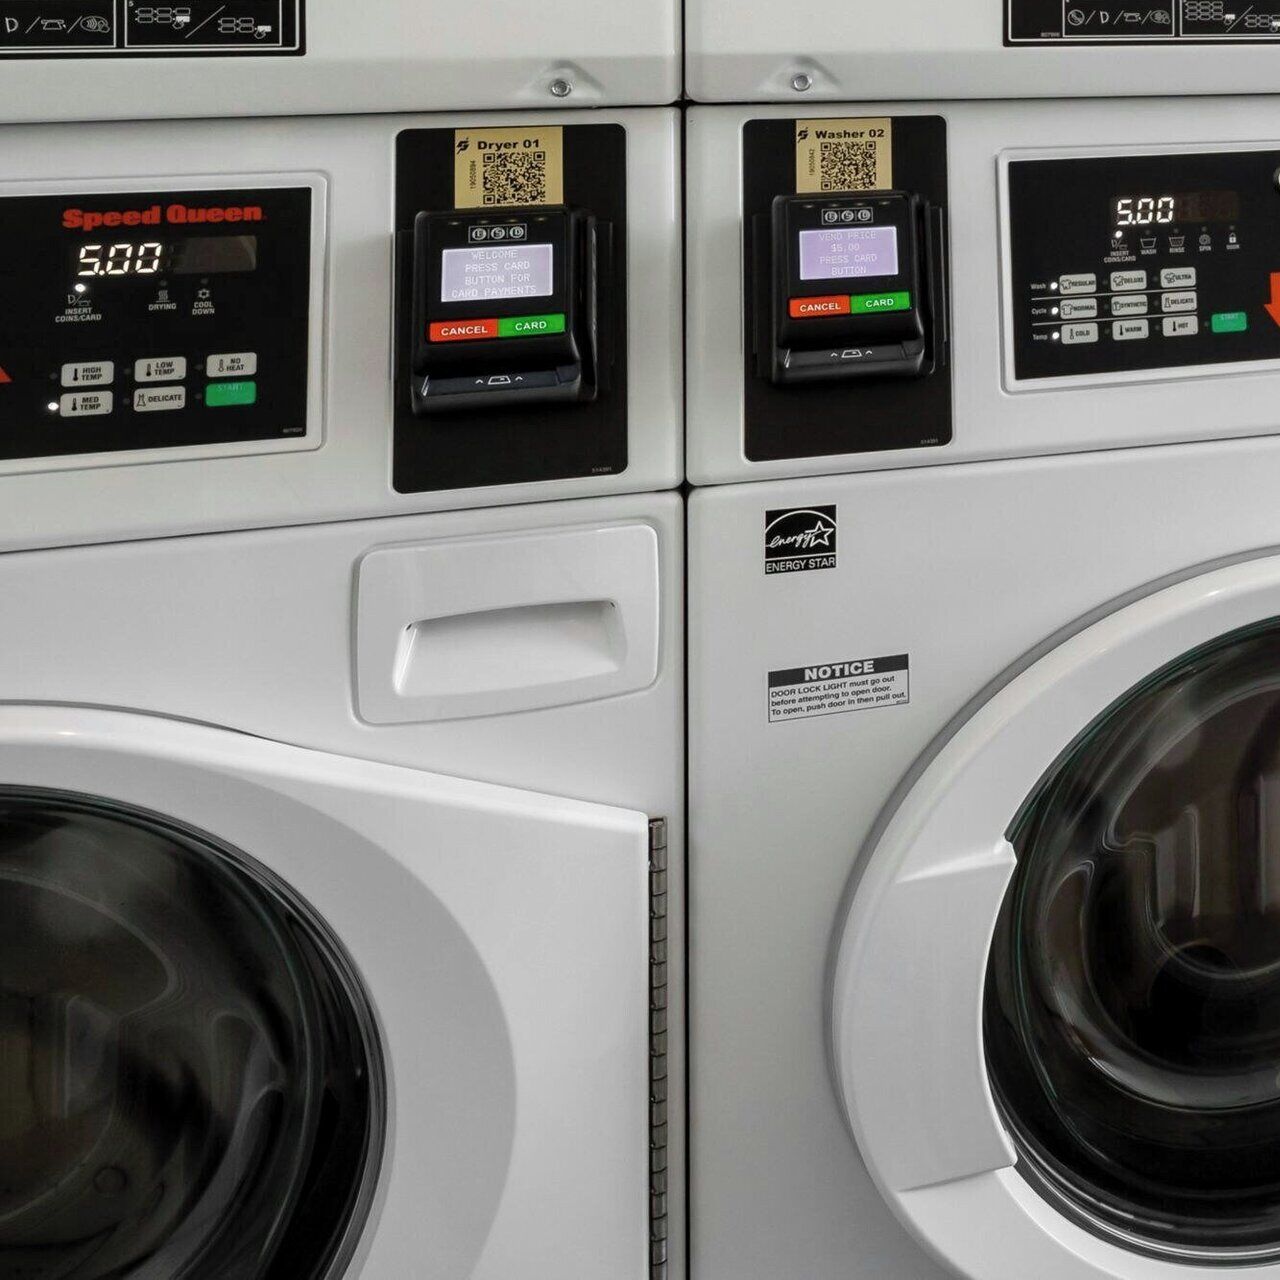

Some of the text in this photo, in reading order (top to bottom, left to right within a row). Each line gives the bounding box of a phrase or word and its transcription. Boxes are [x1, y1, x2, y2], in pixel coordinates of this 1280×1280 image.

[815, 129, 884, 139] Washer 02
[477, 139, 540, 151] Dryer 01
[1117, 197, 1174, 226] 5.00
[62, 204, 262, 231] Speed Queen
[820, 231, 876, 241] VEND PRICE
[78, 242, 162, 276] 5.00
[471, 250, 518, 260] WELCOME
[820, 254, 877, 264] PRESS CARD
[465, 261, 530, 272] PRESS CARD
[831, 267, 867, 275] BUTTON
[465, 274, 530, 285] BUTTON FOR
[452, 286, 536, 298] CARD PAYMENTS
[149, 303, 176, 311] DRYING
[194, 301, 214, 309] COOL
[800, 303, 841, 312] CANCEL
[865, 298, 894, 308] CARD
[1073, 304, 1096, 312] NORMAL
[192, 307, 215, 315] DOWN
[1031, 307, 1047, 315] Cycle
[55, 314, 101, 322] COINS/CARD
[441, 326, 488, 336] CANCEL
[515, 321, 547, 331] CARD
[1033, 333, 1047, 341] Temp
[156, 361, 173, 369] LOW
[226, 364, 245, 372] HEAT
[154, 368, 175, 376] TEMP
[81, 373, 103, 382] TEMP
[148, 394, 182, 402] DELICATE
[80, 402, 101, 411] TEMP
[768, 531, 814, 548] energy
[766, 557, 835, 573] ENERGY STAR
[804, 660, 874, 681] NOTICE
[771, 688, 796, 698] DOOR
[798, 686, 821, 695] LOCK
[823, 682, 847, 691] LIGHT
[849, 680, 868, 688] must
[771, 698, 796, 707] before
[798, 692, 840, 703] attempting
[851, 688, 870, 697] open
[872, 686, 892, 694] door.
[783, 706, 805, 715] open,
[807, 704, 826, 712] push
[828, 700, 846, 708] door
[857, 695, 875, 704] then
[876, 693, 890, 703] pull
